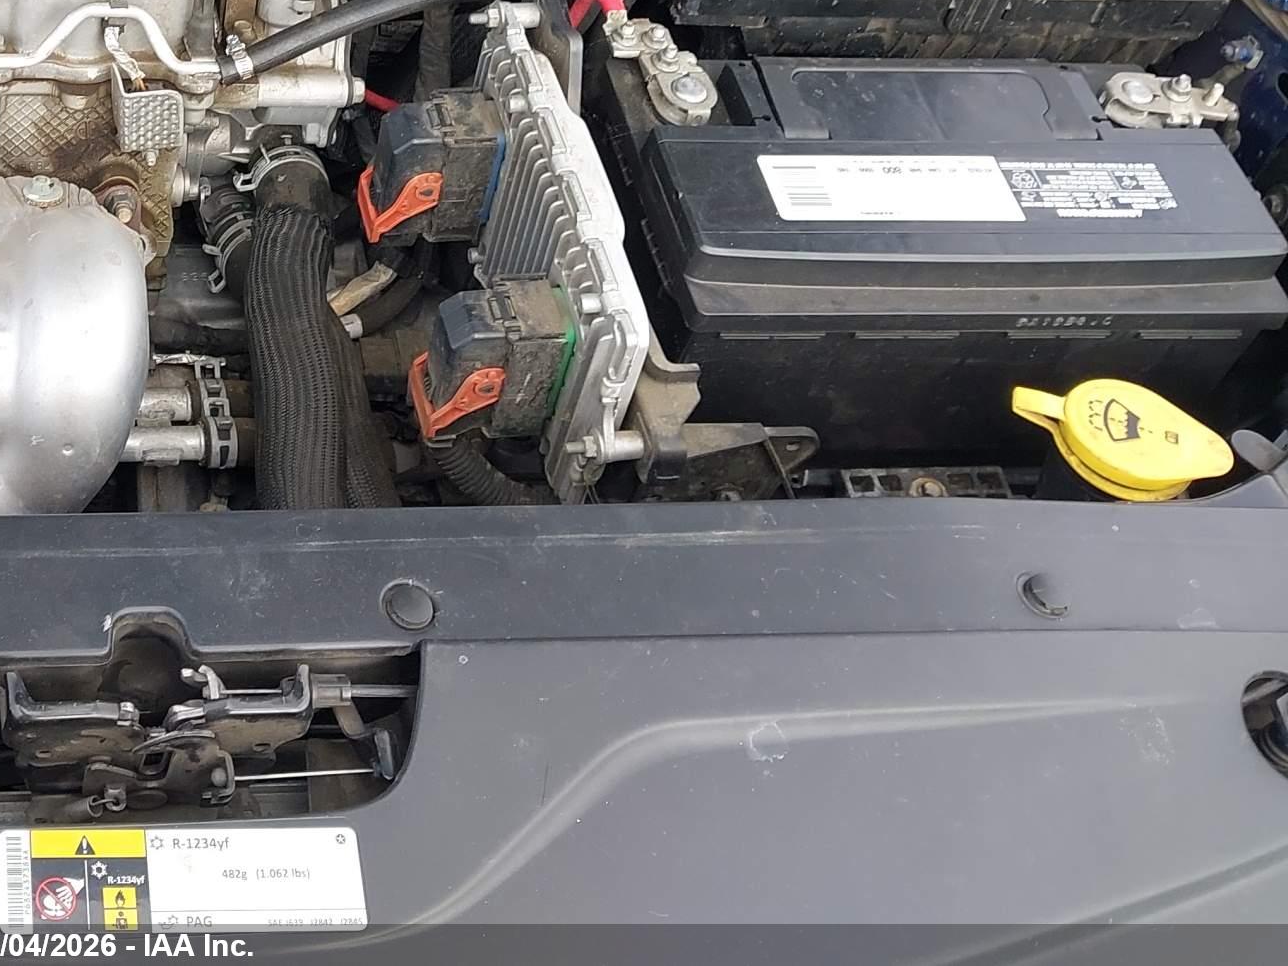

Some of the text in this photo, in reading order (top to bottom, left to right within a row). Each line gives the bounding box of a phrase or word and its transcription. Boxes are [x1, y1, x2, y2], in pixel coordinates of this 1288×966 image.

[172, 837, 230, 851] R-1234yf
[107, 875, 145, 885] R-1234yf
[222, 867, 311, 881] 482g (1.062 lbs)
[186, 915, 213, 928] PAG
